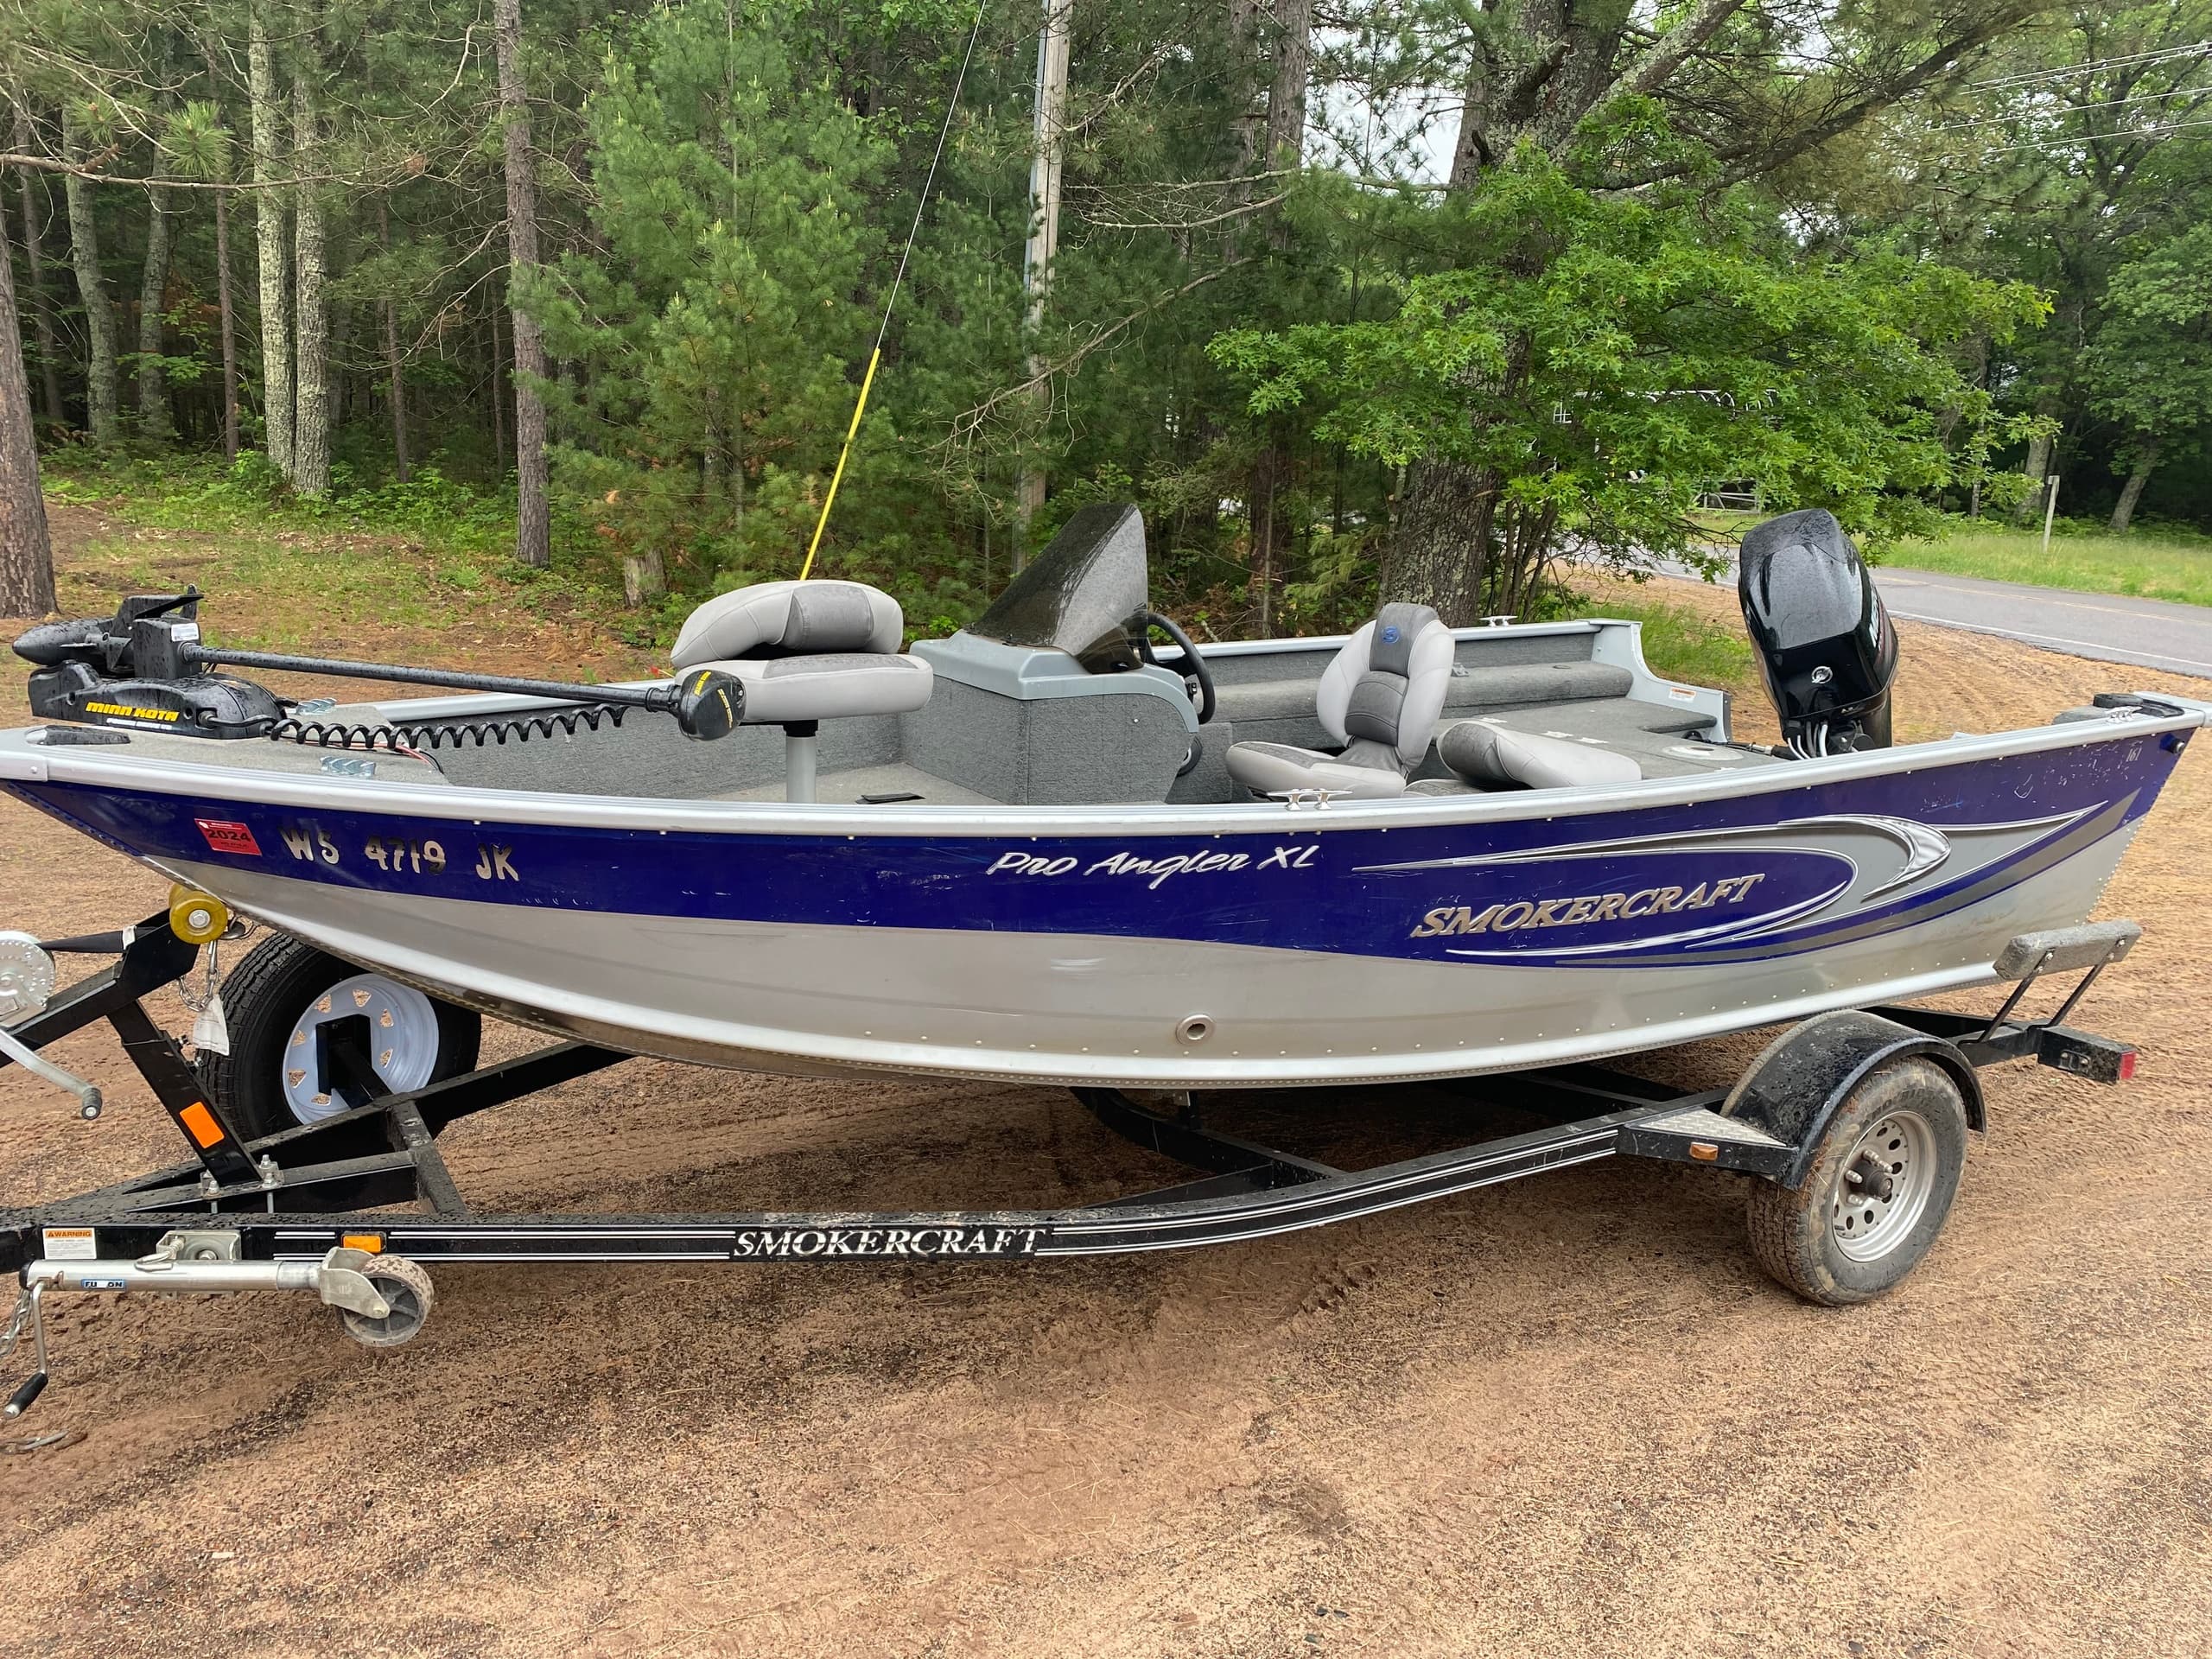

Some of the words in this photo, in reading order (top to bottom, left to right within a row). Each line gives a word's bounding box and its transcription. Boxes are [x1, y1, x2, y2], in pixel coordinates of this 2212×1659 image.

[133, 707, 180, 721] KOTA
[207, 830, 251, 842] 2024
[277, 827, 340, 865] WS
[365, 836, 446, 875] 4719
[475, 842, 519, 881] JK
[1083, 850, 1251, 889] Angler
[1256, 846, 1319, 869] XL
[1410, 873, 1765, 938] SMOKERCRAFT
[54, 1230, 91, 1238] WARNING
[734, 1229, 1046, 1255] SMOKERCRAFT
